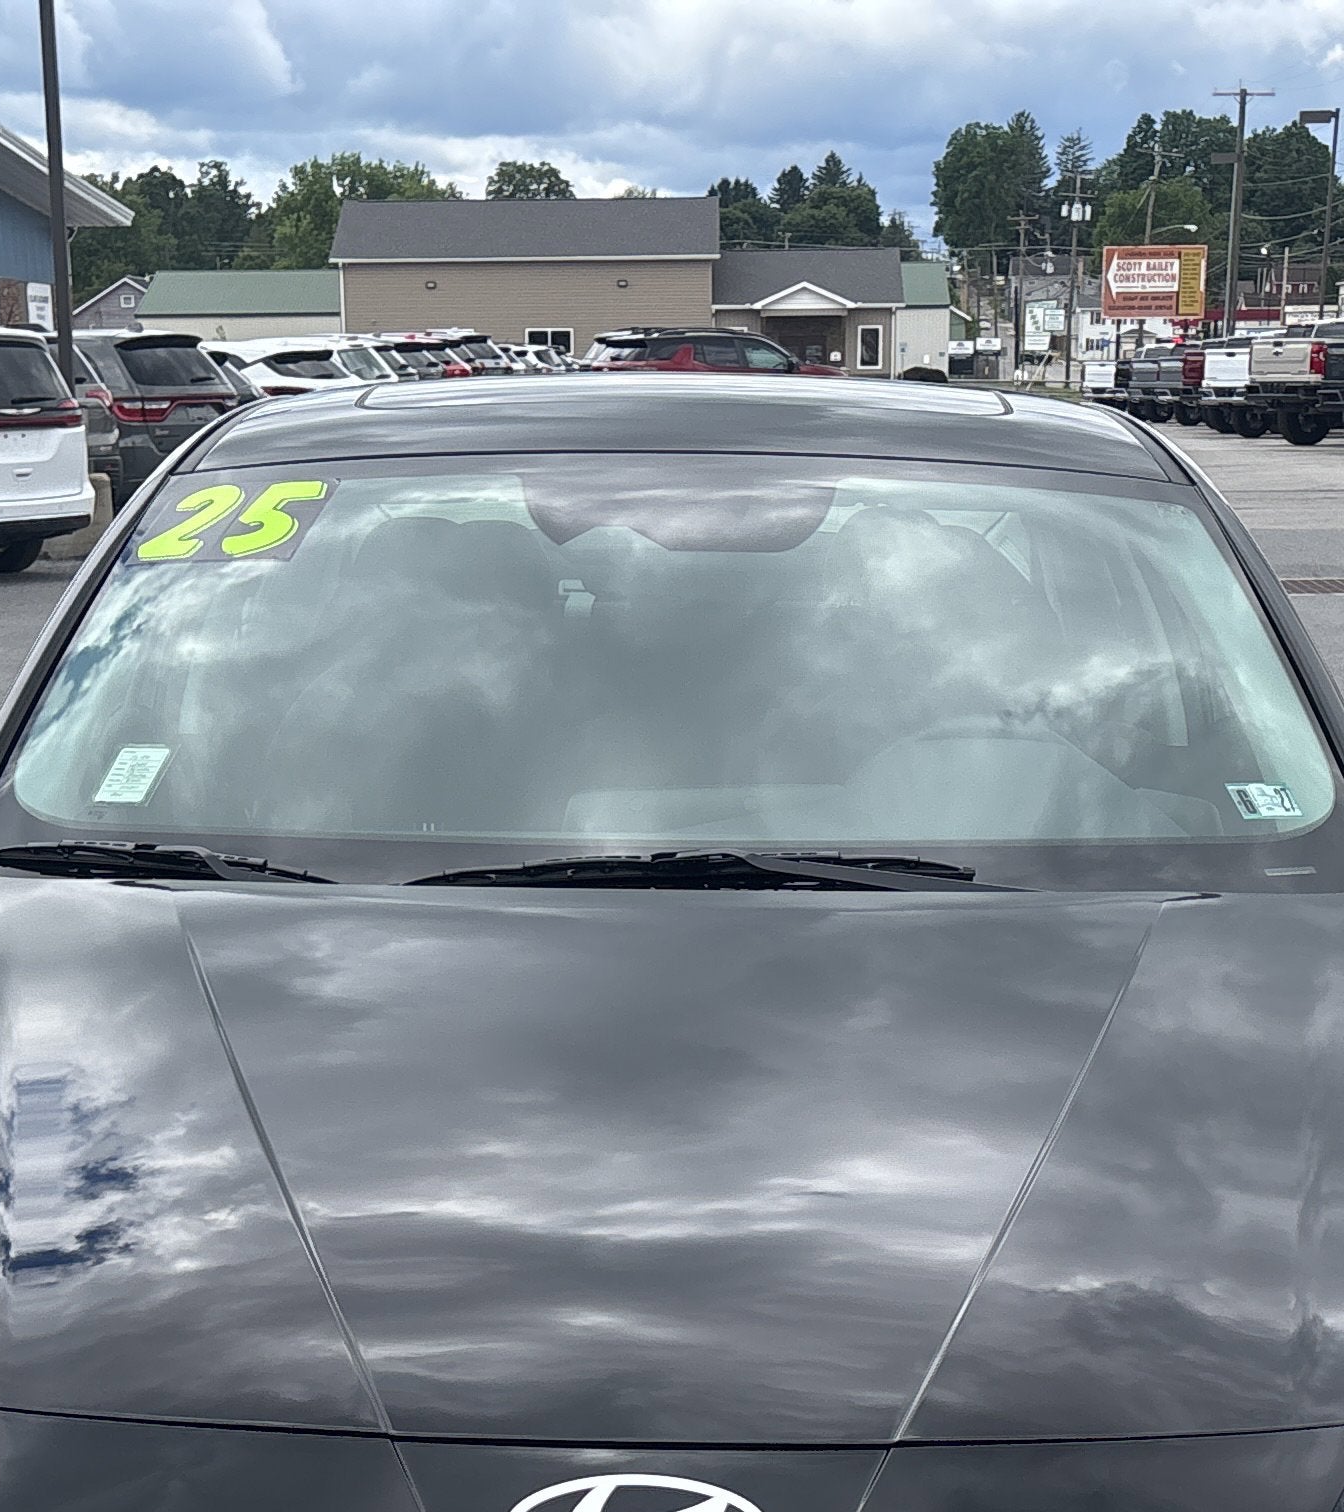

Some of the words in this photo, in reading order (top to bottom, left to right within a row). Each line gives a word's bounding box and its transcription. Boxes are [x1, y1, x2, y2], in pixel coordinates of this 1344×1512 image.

[1115, 261, 1143, 272] SCOTT
[1146, 261, 1175, 272] BAILEY
[1113, 273, 1177, 283] CONSTRUCTION
[137, 480, 328, 561] 25
